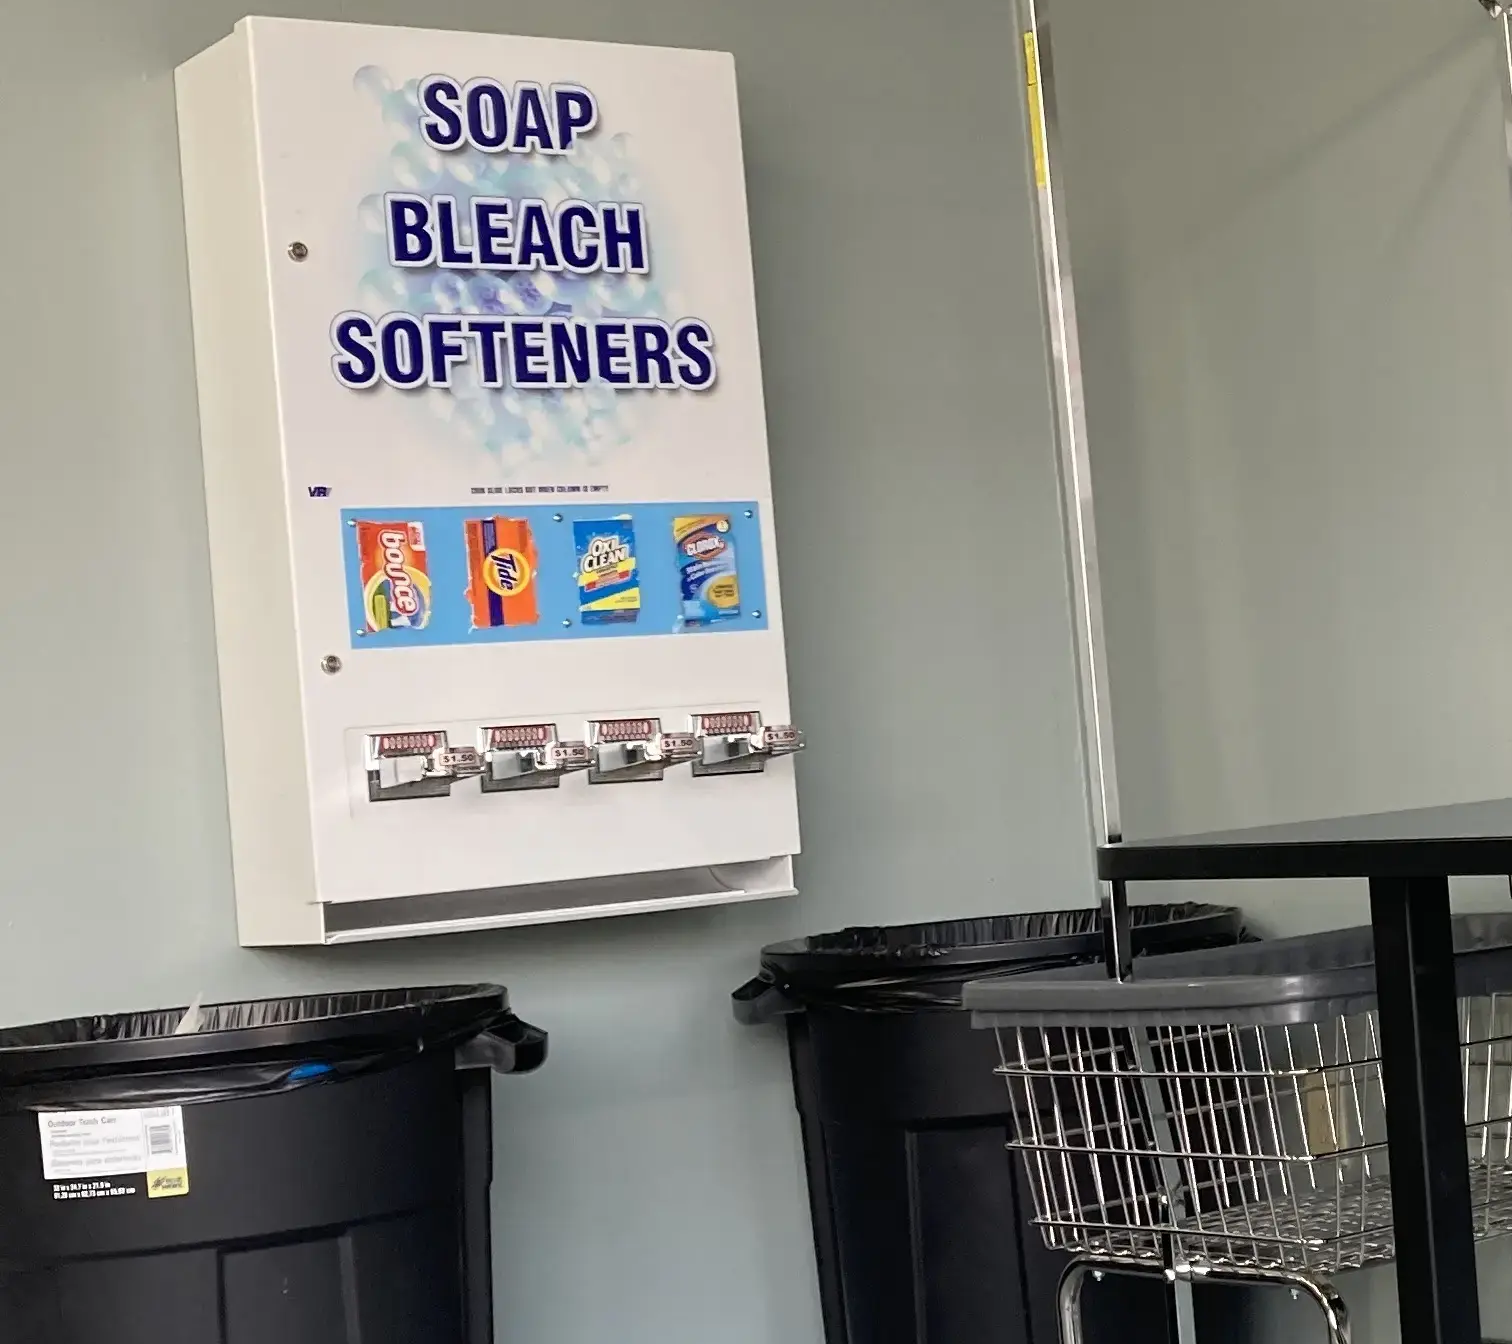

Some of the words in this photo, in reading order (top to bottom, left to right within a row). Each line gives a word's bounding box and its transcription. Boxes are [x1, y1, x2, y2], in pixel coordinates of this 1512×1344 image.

[421, 77, 596, 152] SOAP
[387, 196, 647, 271] BLEACH
[332, 314, 714, 388] SOFTENERS
[584, 546, 627, 573] CLEAN
[592, 538, 616, 557] OXI
[379, 530, 417, 614] bounce
[490, 553, 518, 591] Tide
[554, 748, 585, 758] $1.50
[664, 739, 693, 748] $1.50
